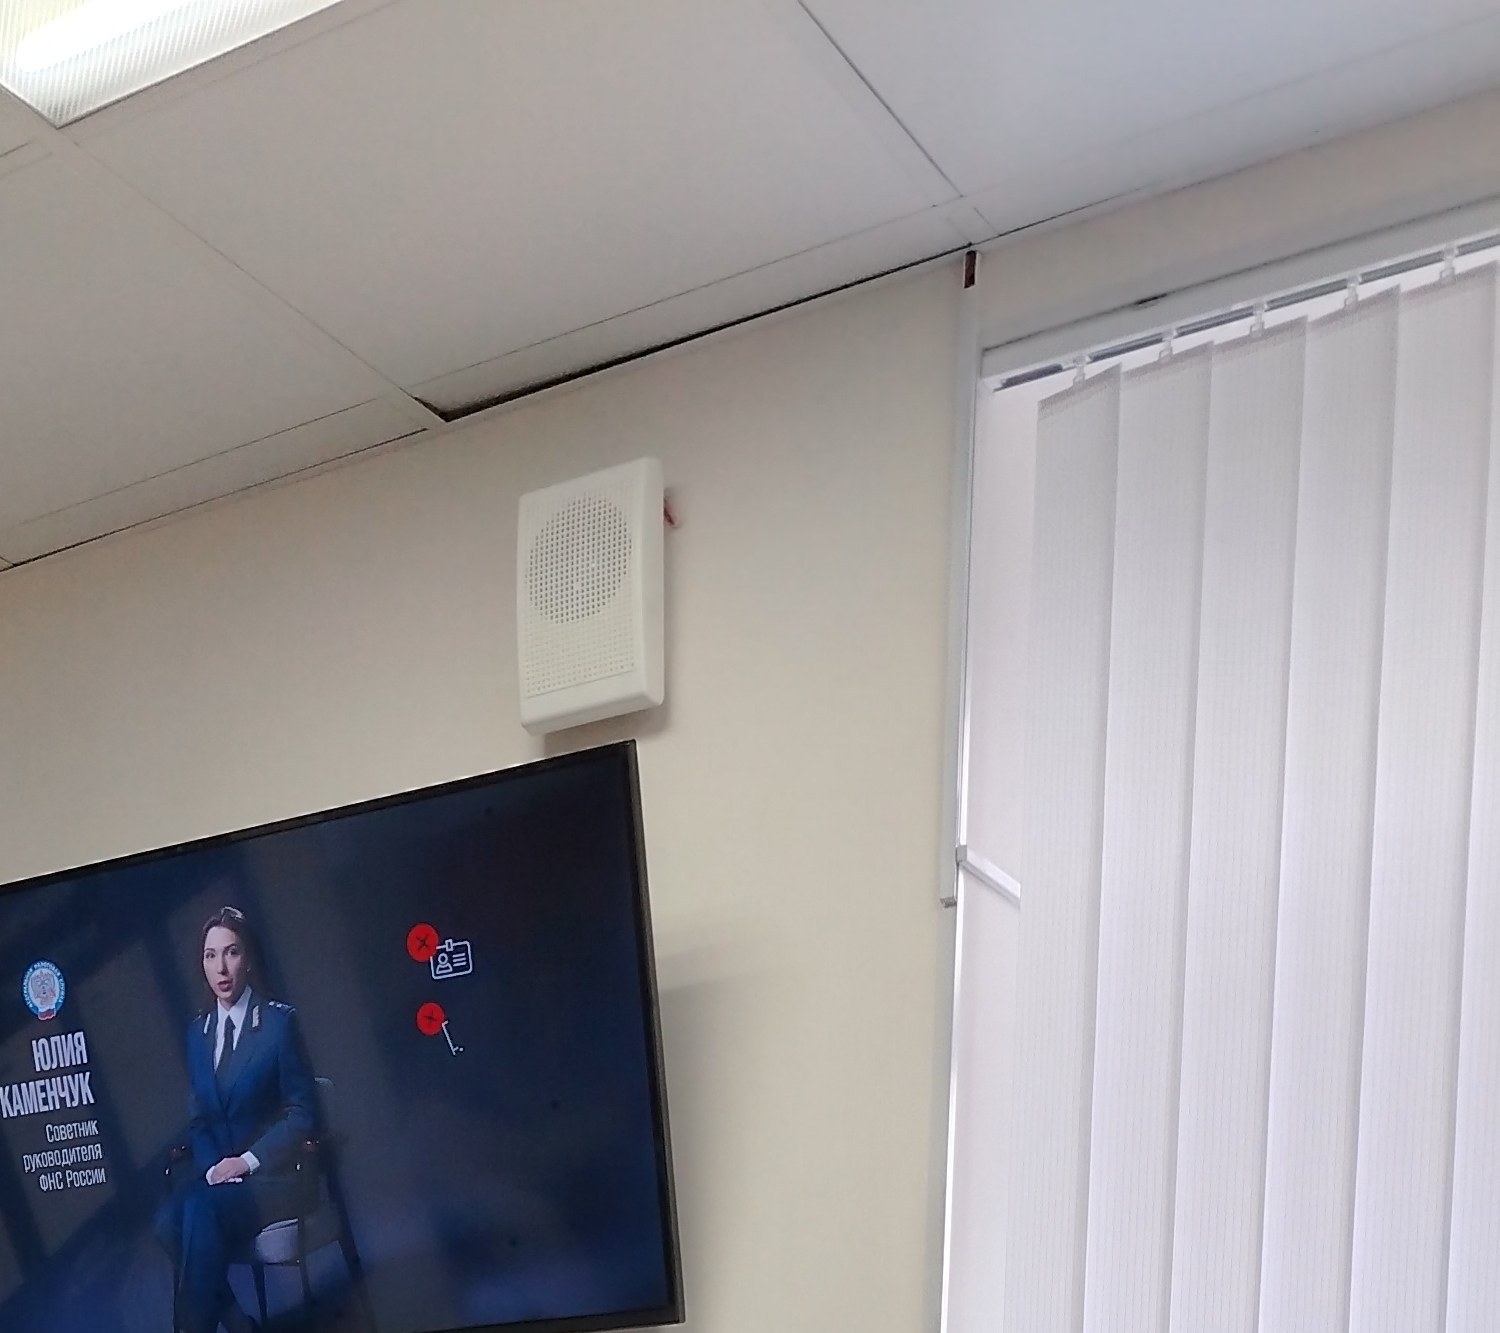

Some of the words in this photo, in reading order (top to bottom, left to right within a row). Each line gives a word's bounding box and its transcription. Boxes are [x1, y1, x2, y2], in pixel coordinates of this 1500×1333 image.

[31, 1031, 89, 1072] ЮЛИЯ
[45, 1119, 100, 1143] Советник
[22, 1143, 103, 1174] руководителя
[39, 1171, 64, 1192] ФНС
[66, 1167, 107, 1189] России
